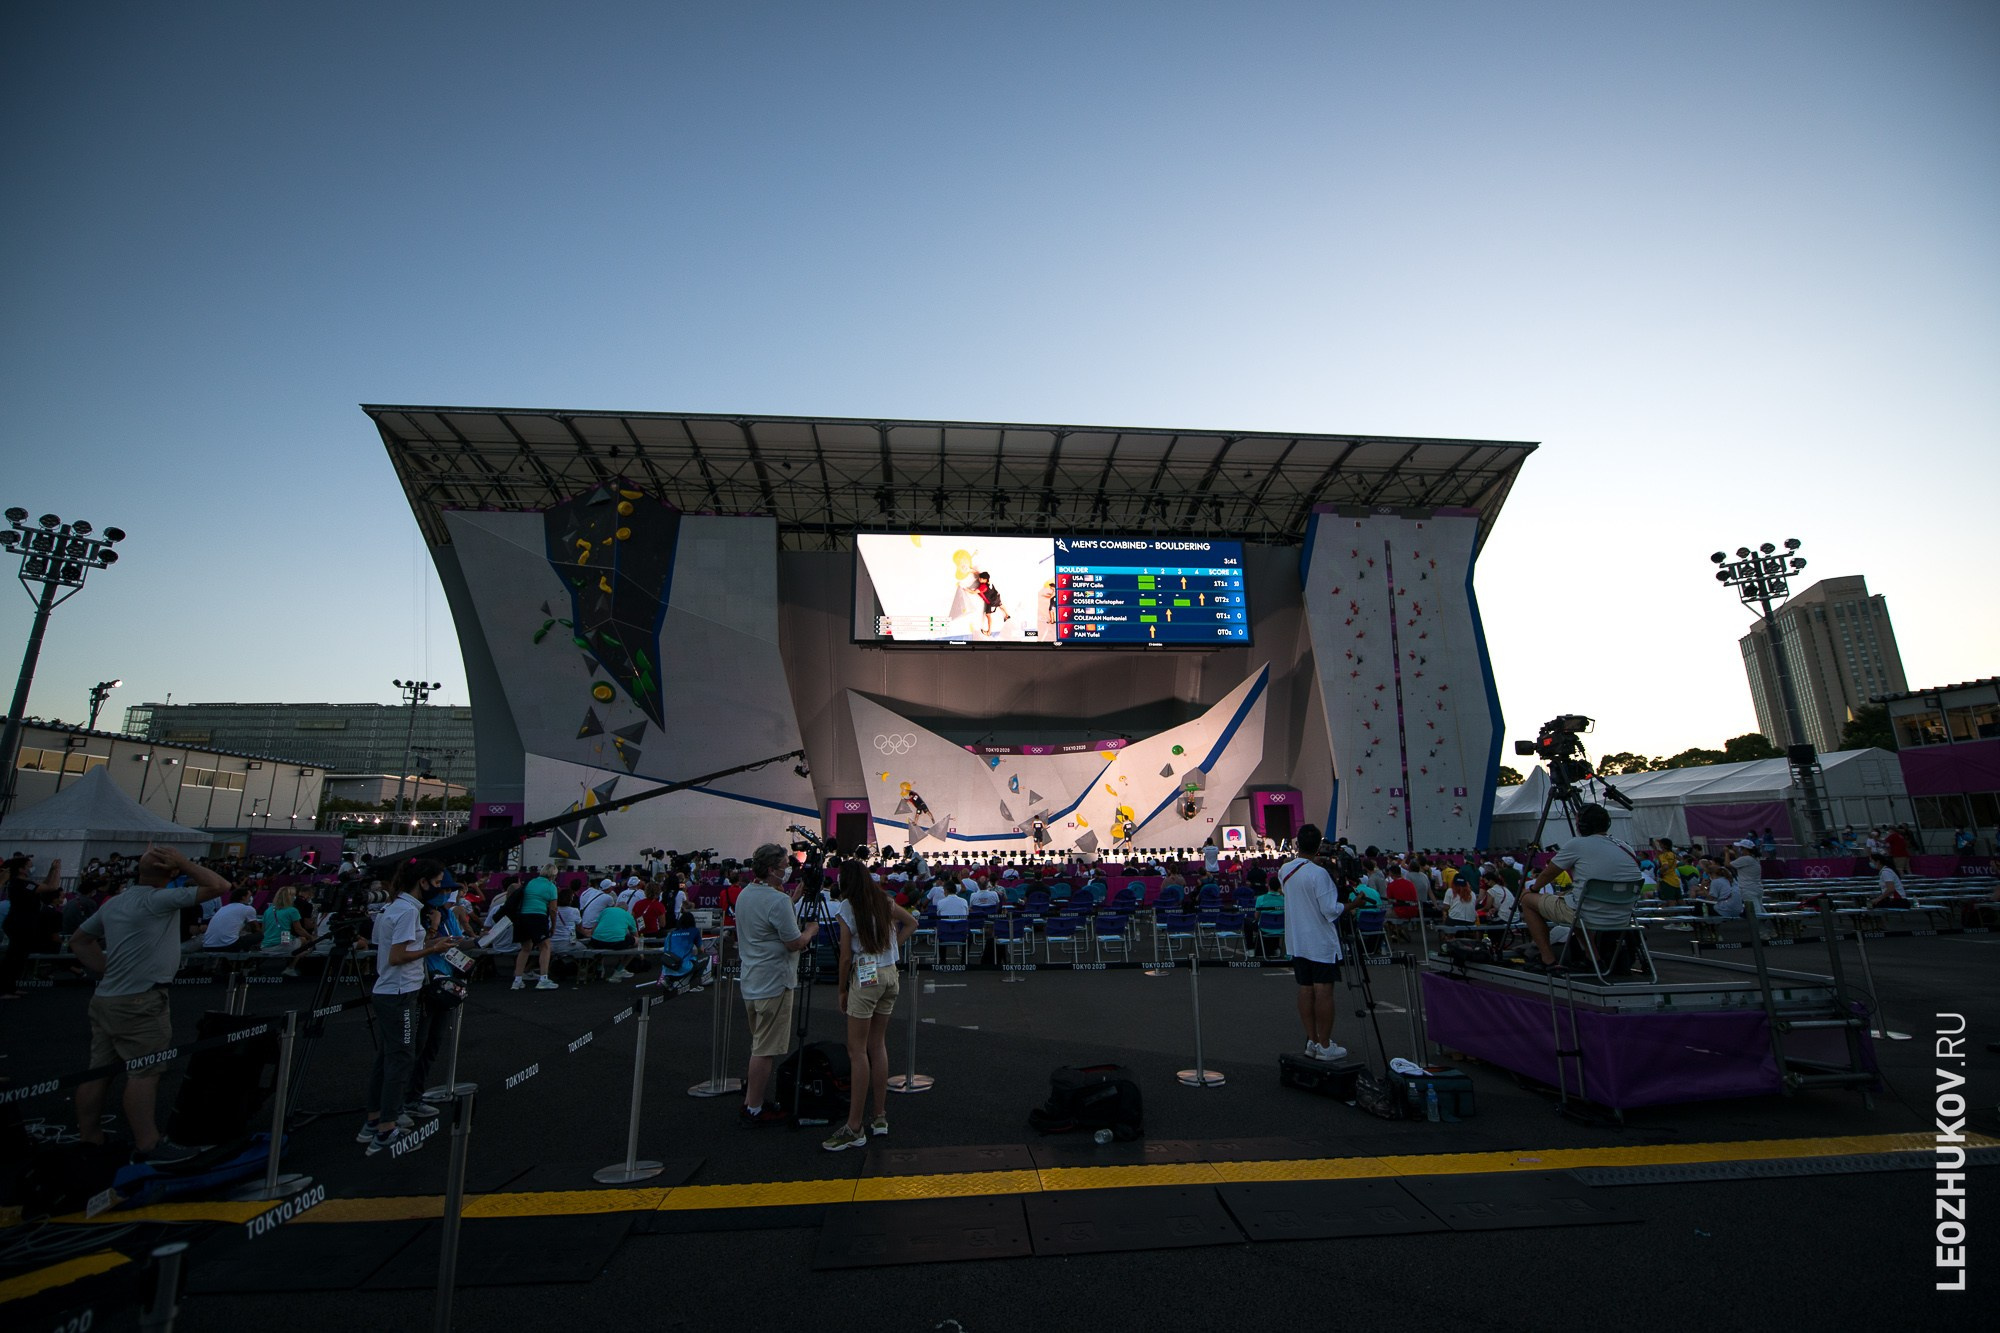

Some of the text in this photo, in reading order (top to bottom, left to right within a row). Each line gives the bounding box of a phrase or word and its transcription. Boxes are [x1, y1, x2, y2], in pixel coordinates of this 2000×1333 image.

[1071, 541, 1098, 549] MEN'S
[1100, 541, 1147, 550] COMBINED
[1155, 542, 1210, 550] BOULDERING
[699, 896, 720, 906] TOK
[312, 1004, 342, 1018] TOKYO 2020
[227, 1024, 268, 1044] TOKYO 2020
[568, 1031, 592, 1054] TOKYO 2020
[126, 1048, 178, 1071] TOKYO 2020
[506, 1062, 539, 1090] TOKYO 2020
[30, 1079, 60, 1097] 2020
[390, 1118, 440, 1159] TOKYO 2020
[246, 1184, 326, 1240] TOKYO 2020
